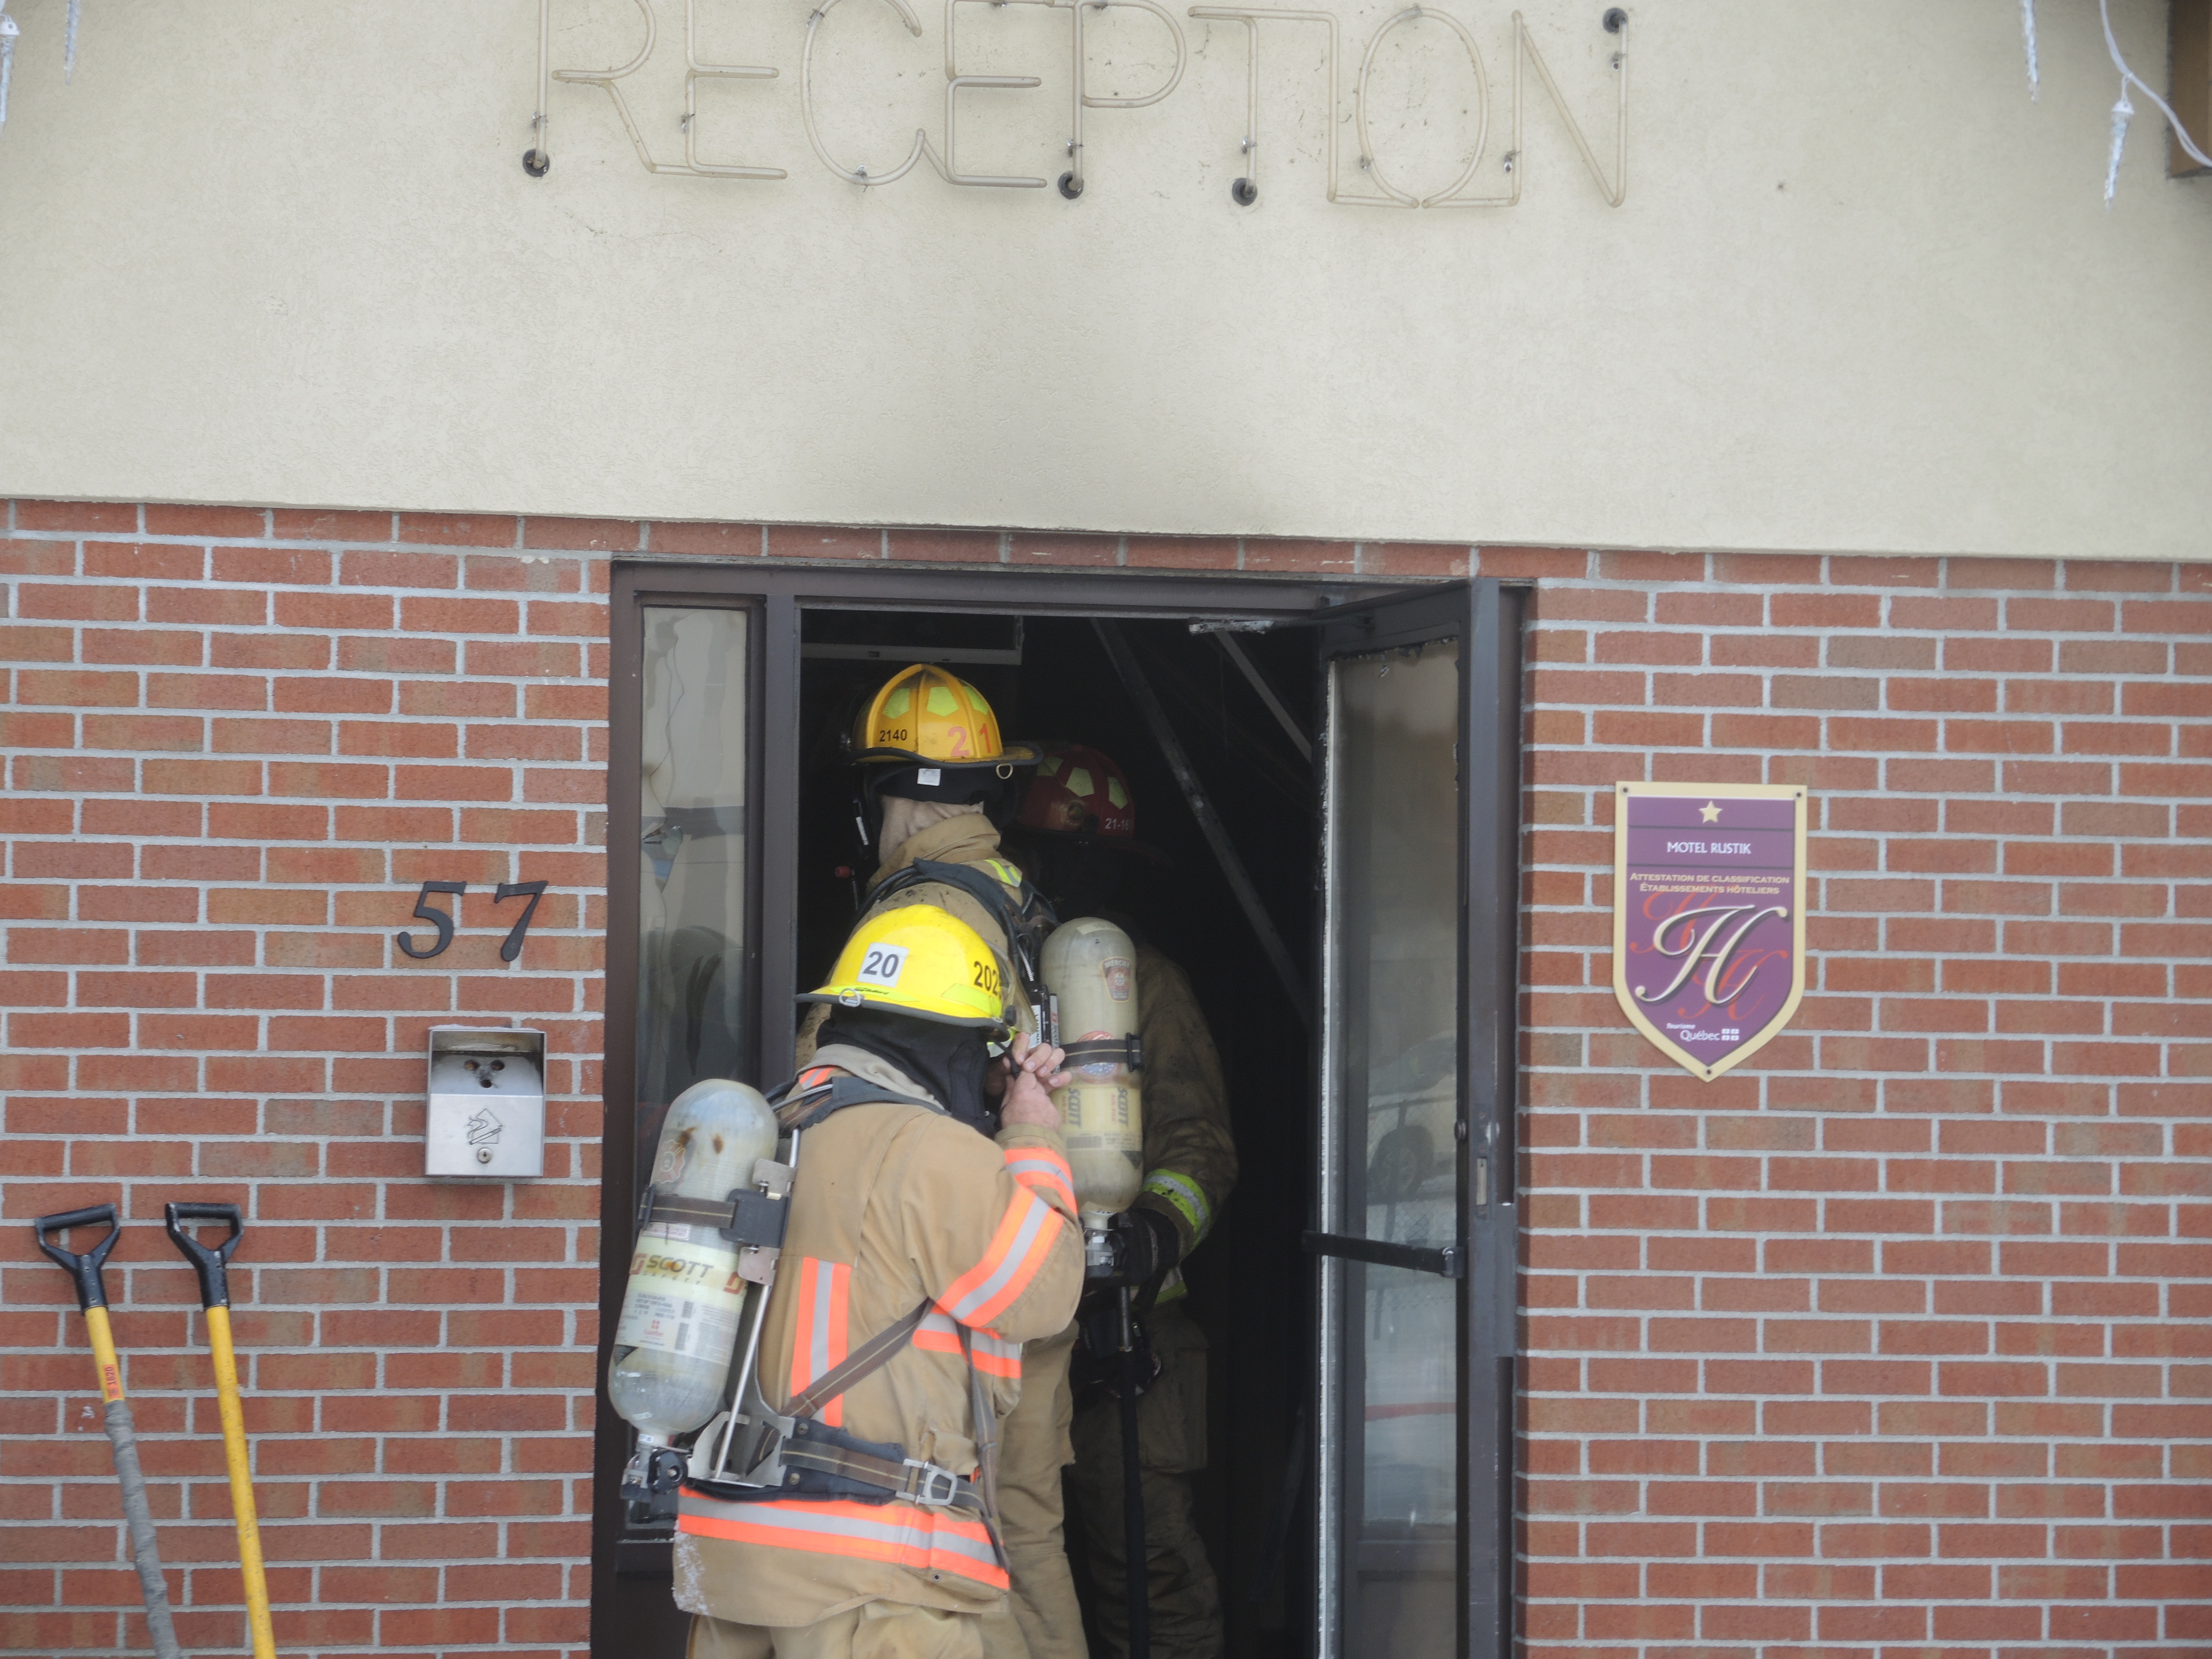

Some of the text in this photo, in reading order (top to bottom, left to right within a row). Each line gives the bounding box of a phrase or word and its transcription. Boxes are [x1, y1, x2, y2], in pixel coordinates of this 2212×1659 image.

[879, 729, 908, 742] 2140
[1667, 841, 1752, 854] MOTEL RUSTIK
[1711, 875, 1791, 884] CLASSIFICATION
[397, 880, 549, 962] 57
[862, 951, 899, 978] 20
[974, 961, 1001, 999] 202
[1679, 1030, 1720, 1042] Québec
[1068, 1087, 1081, 1127] SCOTT
[1118, 1087, 1129, 1126] SCOTT
[643, 1271, 702, 1285] SAFETY
[646, 1254, 714, 1278] SCOTT
